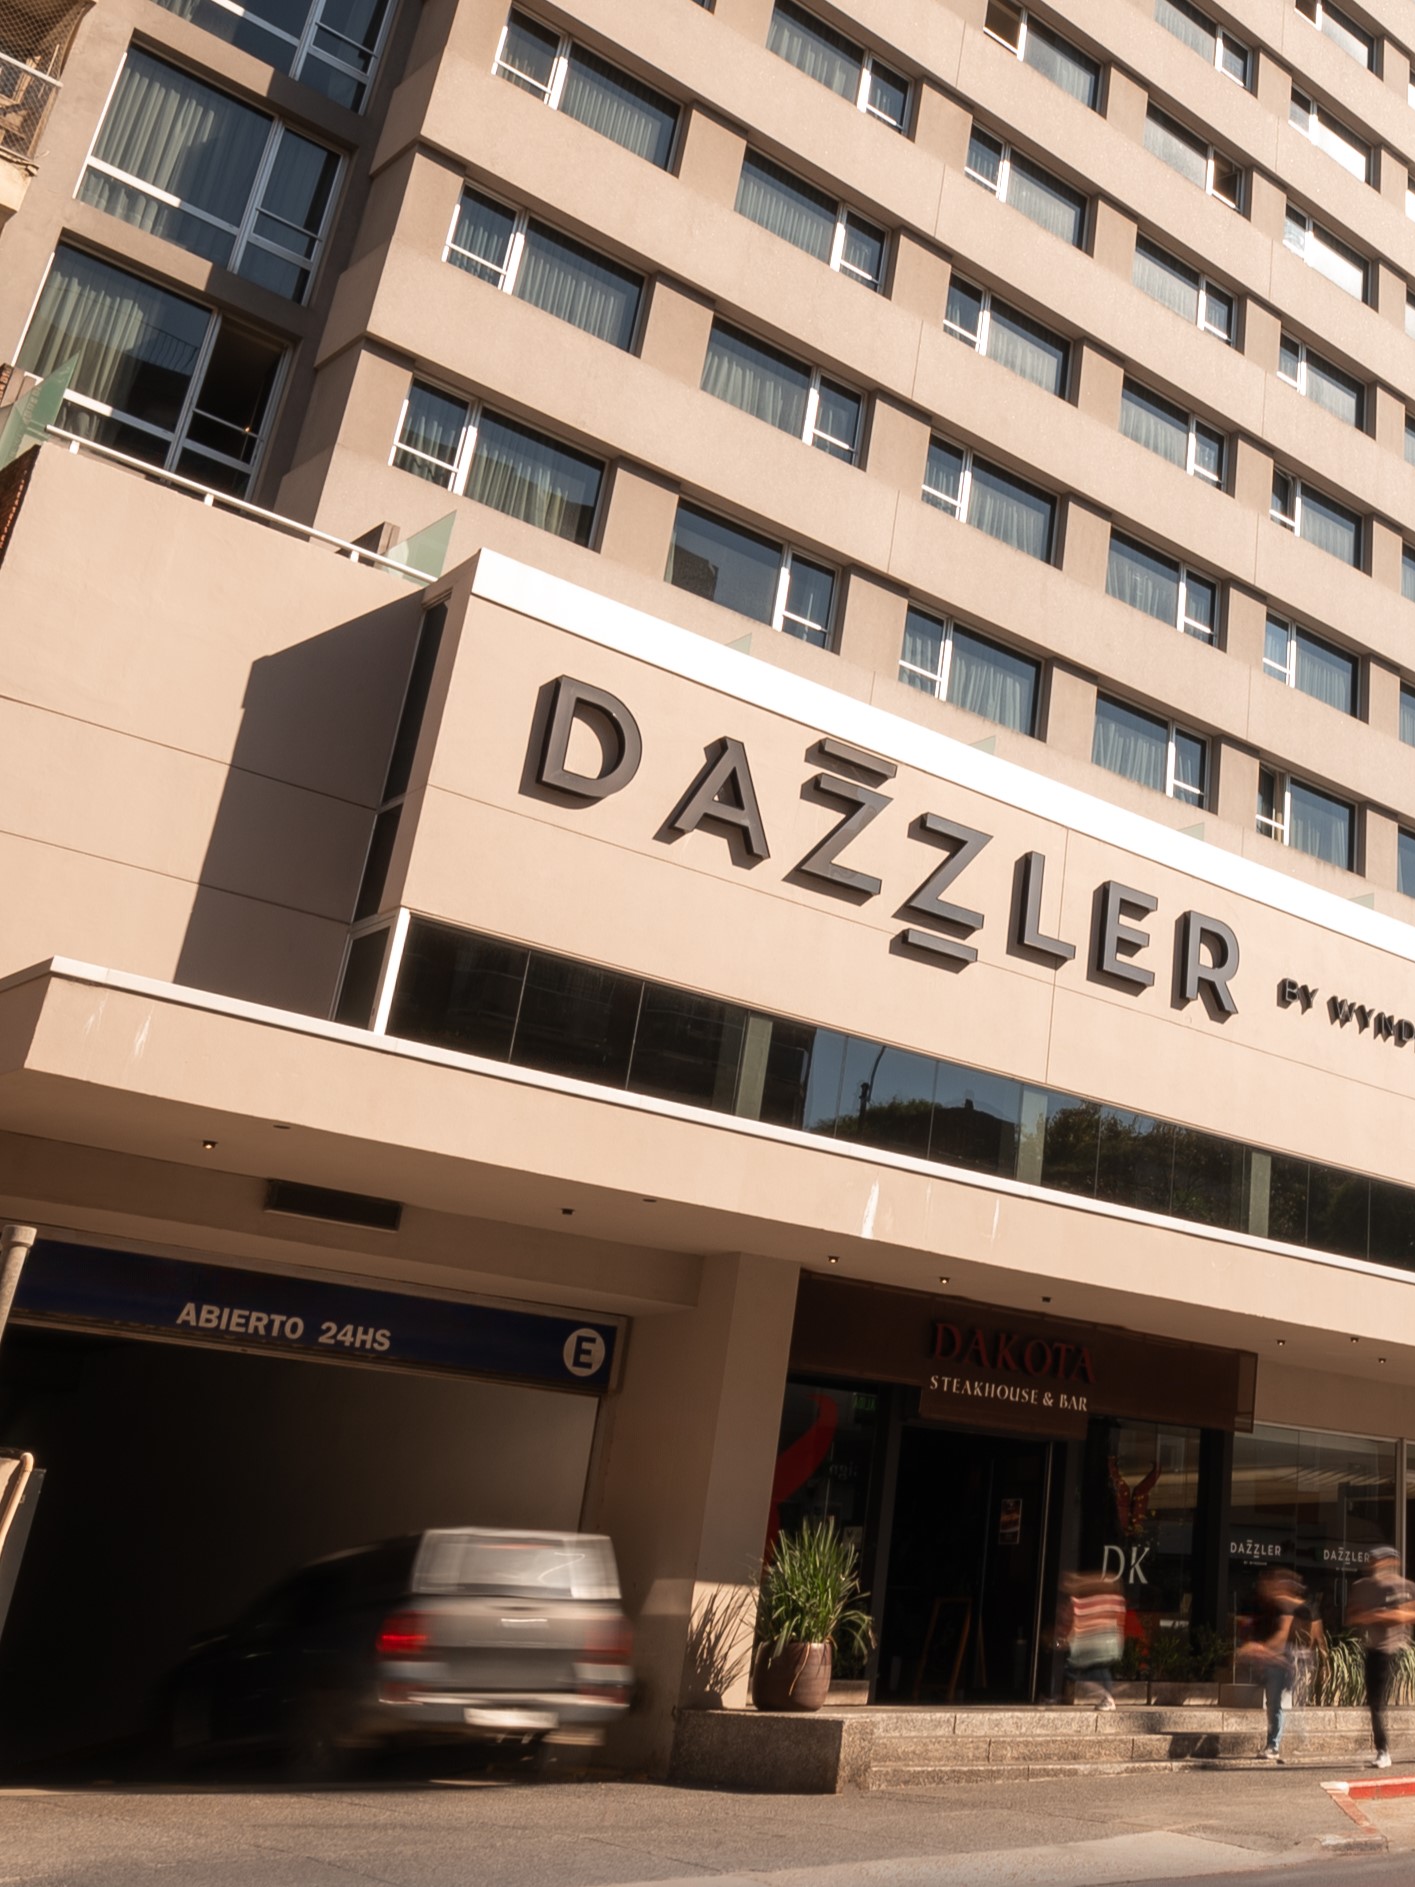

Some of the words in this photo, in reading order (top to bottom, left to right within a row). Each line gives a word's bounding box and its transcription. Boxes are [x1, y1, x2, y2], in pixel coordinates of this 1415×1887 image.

[536, 674, 1240, 1015] DAZZLER
[1279, 976, 1318, 1012] BY
[176, 1301, 305, 1341] ABIERTO
[318, 1319, 392, 1352] 24HS
[572, 1335, 597, 1369] E
[931, 1321, 1097, 1384] DAKOTA
[929, 1374, 1040, 1405] STEAKHOUSE
[1042, 1391, 1054, 1407] &
[1058, 1393, 1089, 1413] BAR
[1101, 1544, 1151, 1585] DK
[1230, 1539, 1282, 1559] DAZZLER
[1323, 1546, 1370, 1565] DAZZLER
